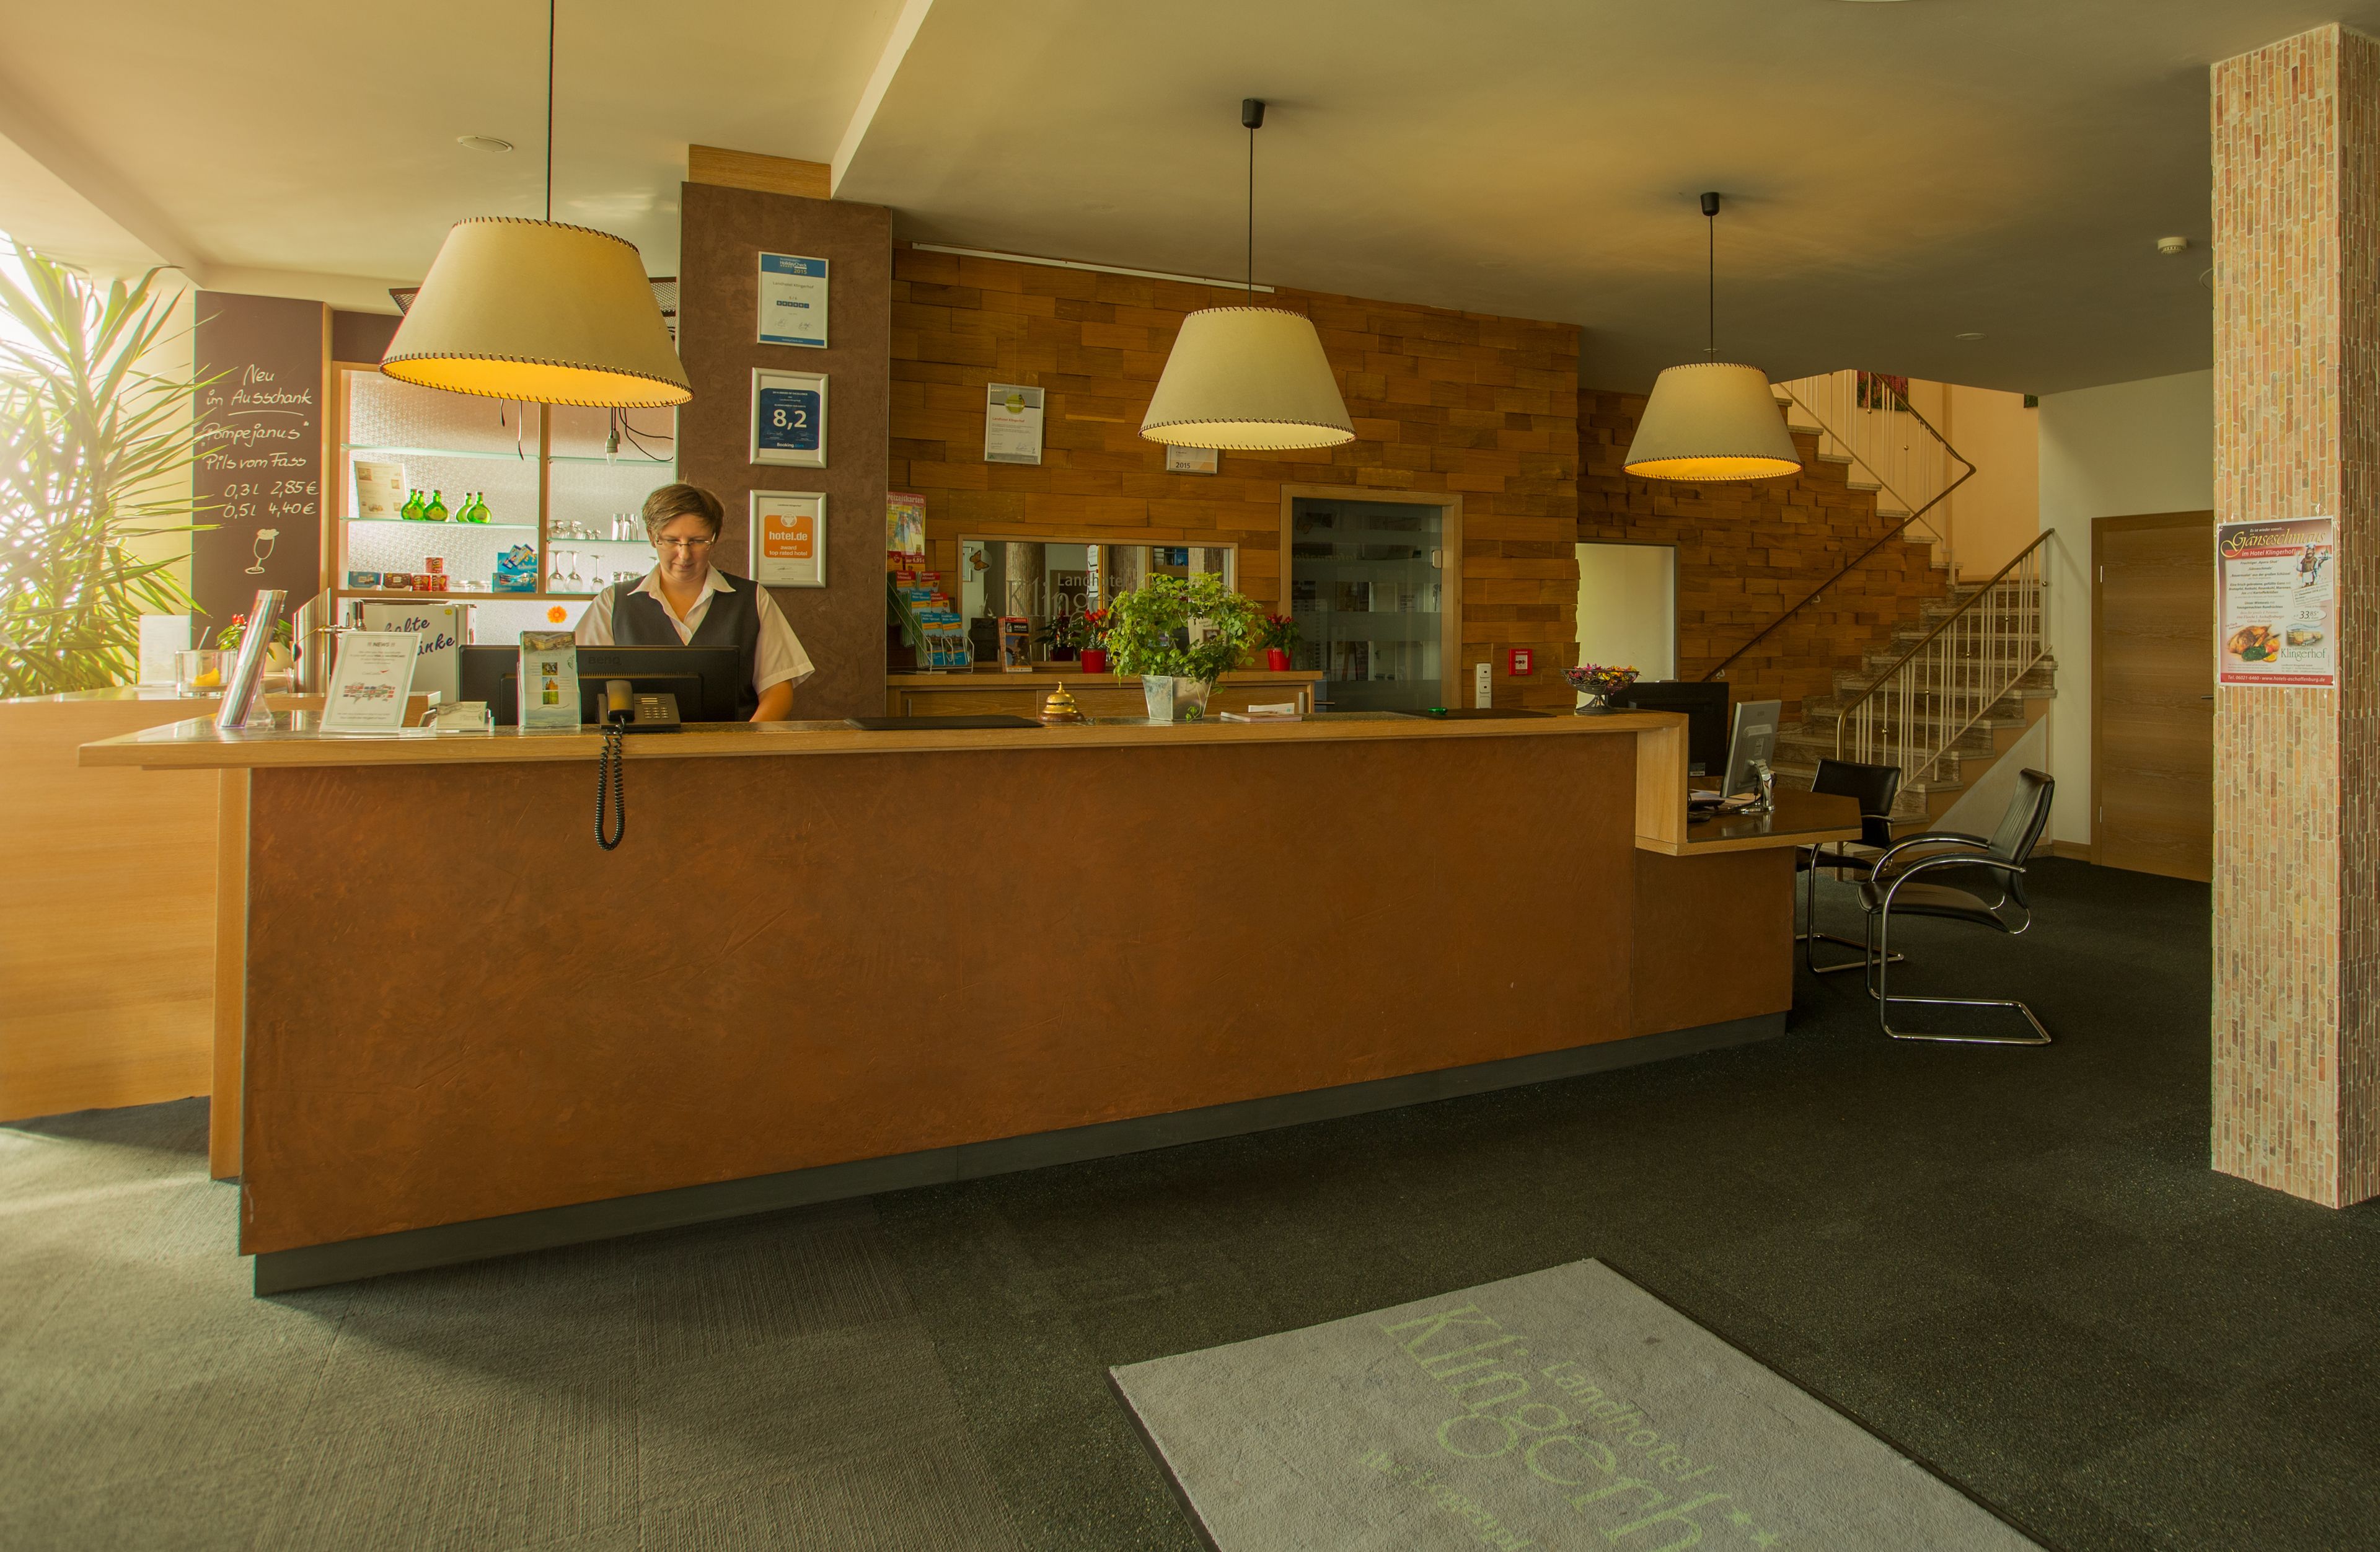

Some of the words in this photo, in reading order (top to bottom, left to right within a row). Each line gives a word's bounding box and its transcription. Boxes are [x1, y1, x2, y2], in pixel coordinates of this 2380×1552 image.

[243, 364, 275, 386] Neu
[206, 390, 223, 406] im
[231, 388, 313, 406] Ausschank
[774, 408, 807, 431] 8,2
[202, 453, 236, 470] Pils
[239, 458, 268, 469] vom
[270, 452, 307, 468] Fass
[888, 494, 924, 504] reizeitkarten
[769, 531, 808, 541] hotel.de
[2221, 528, 2326, 558] Gänseschmaus
[2265, 549, 2296, 557] Klingerhof!
[1057, 573, 1124, 587] Landhote
[588, 656, 622, 665] BenQ
[2281, 648, 2327, 662] Klingerhof
[1541, 1360, 1719, 1484] Landhotel
